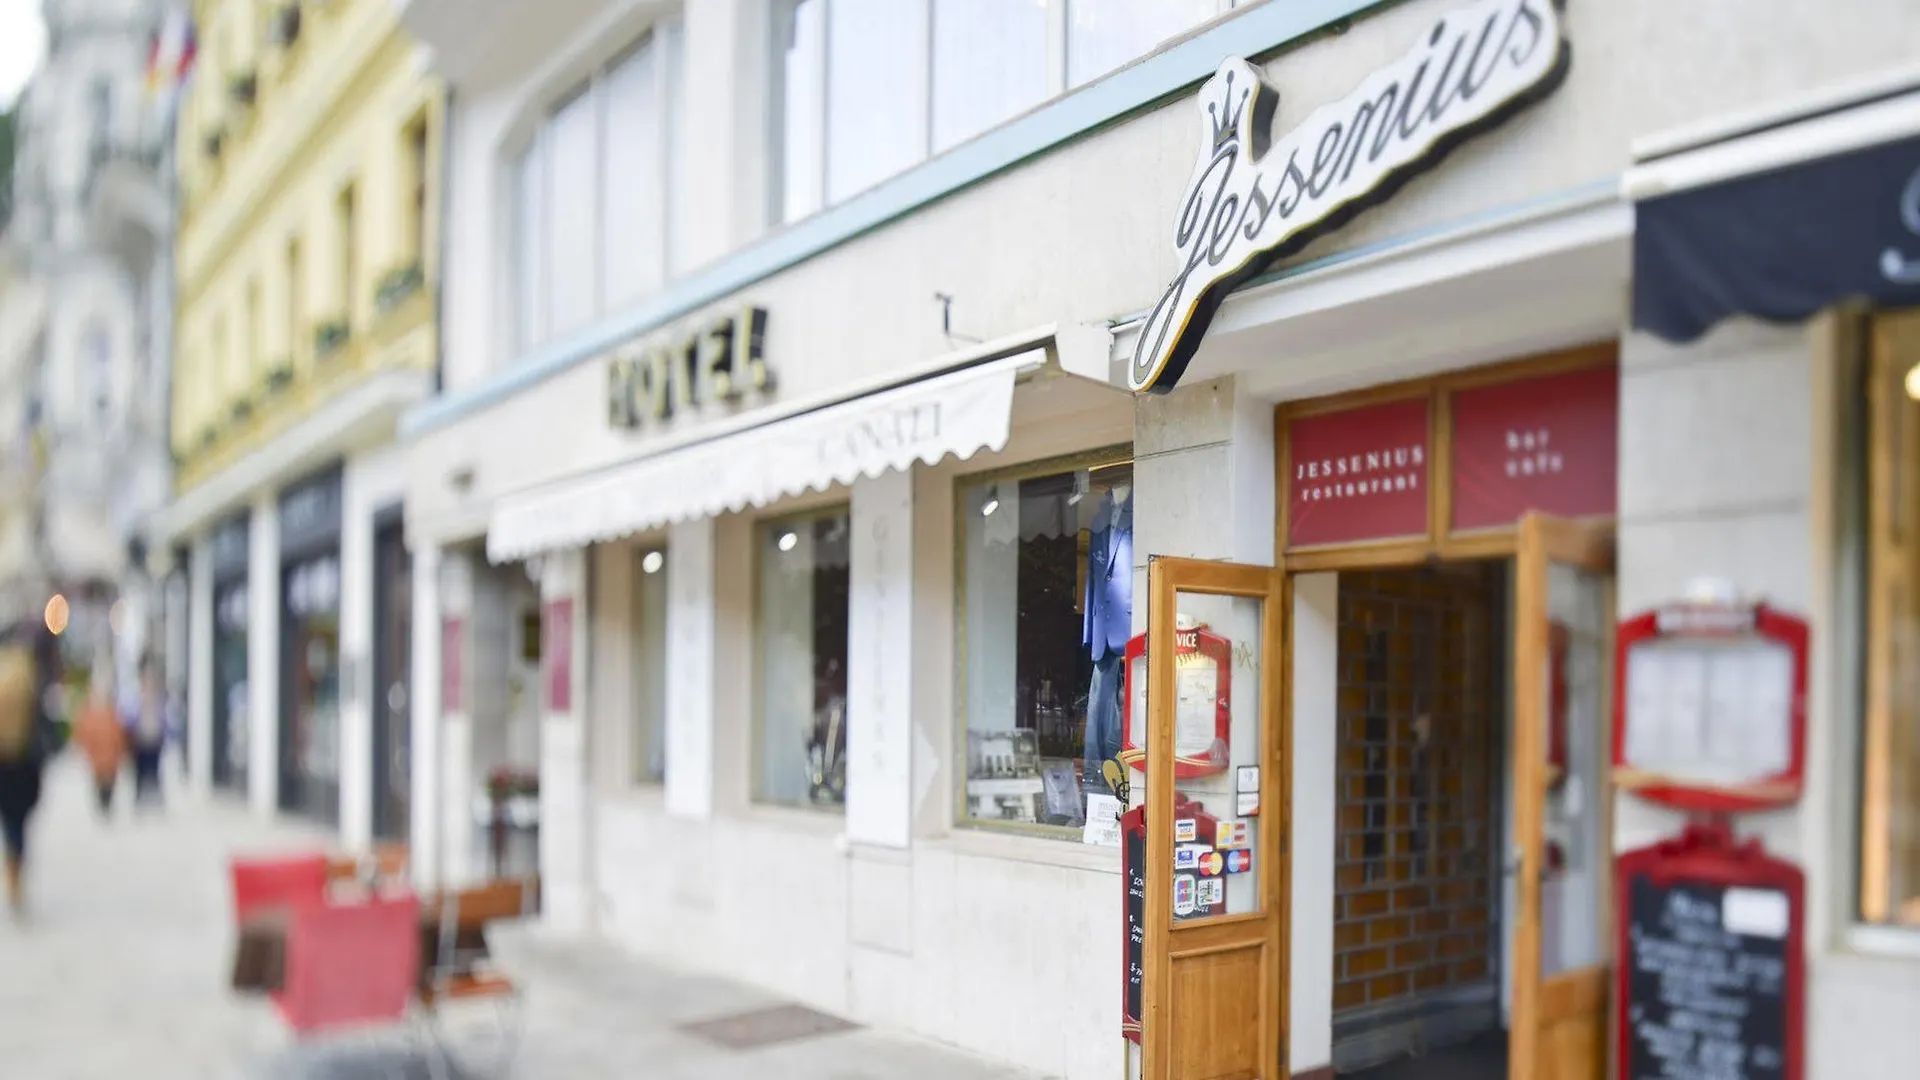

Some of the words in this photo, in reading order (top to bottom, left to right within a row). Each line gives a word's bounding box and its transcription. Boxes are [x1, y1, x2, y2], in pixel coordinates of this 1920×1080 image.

[1134, 0, 1544, 384] Jessenius
[608, 305, 768, 428] HOTEL
[1505, 428, 1550, 452] bar
[1296, 444, 1424, 480] JESSENIUS
[1301, 472, 1418, 502] restaurant
[1176, 633, 1197, 648] VICE
